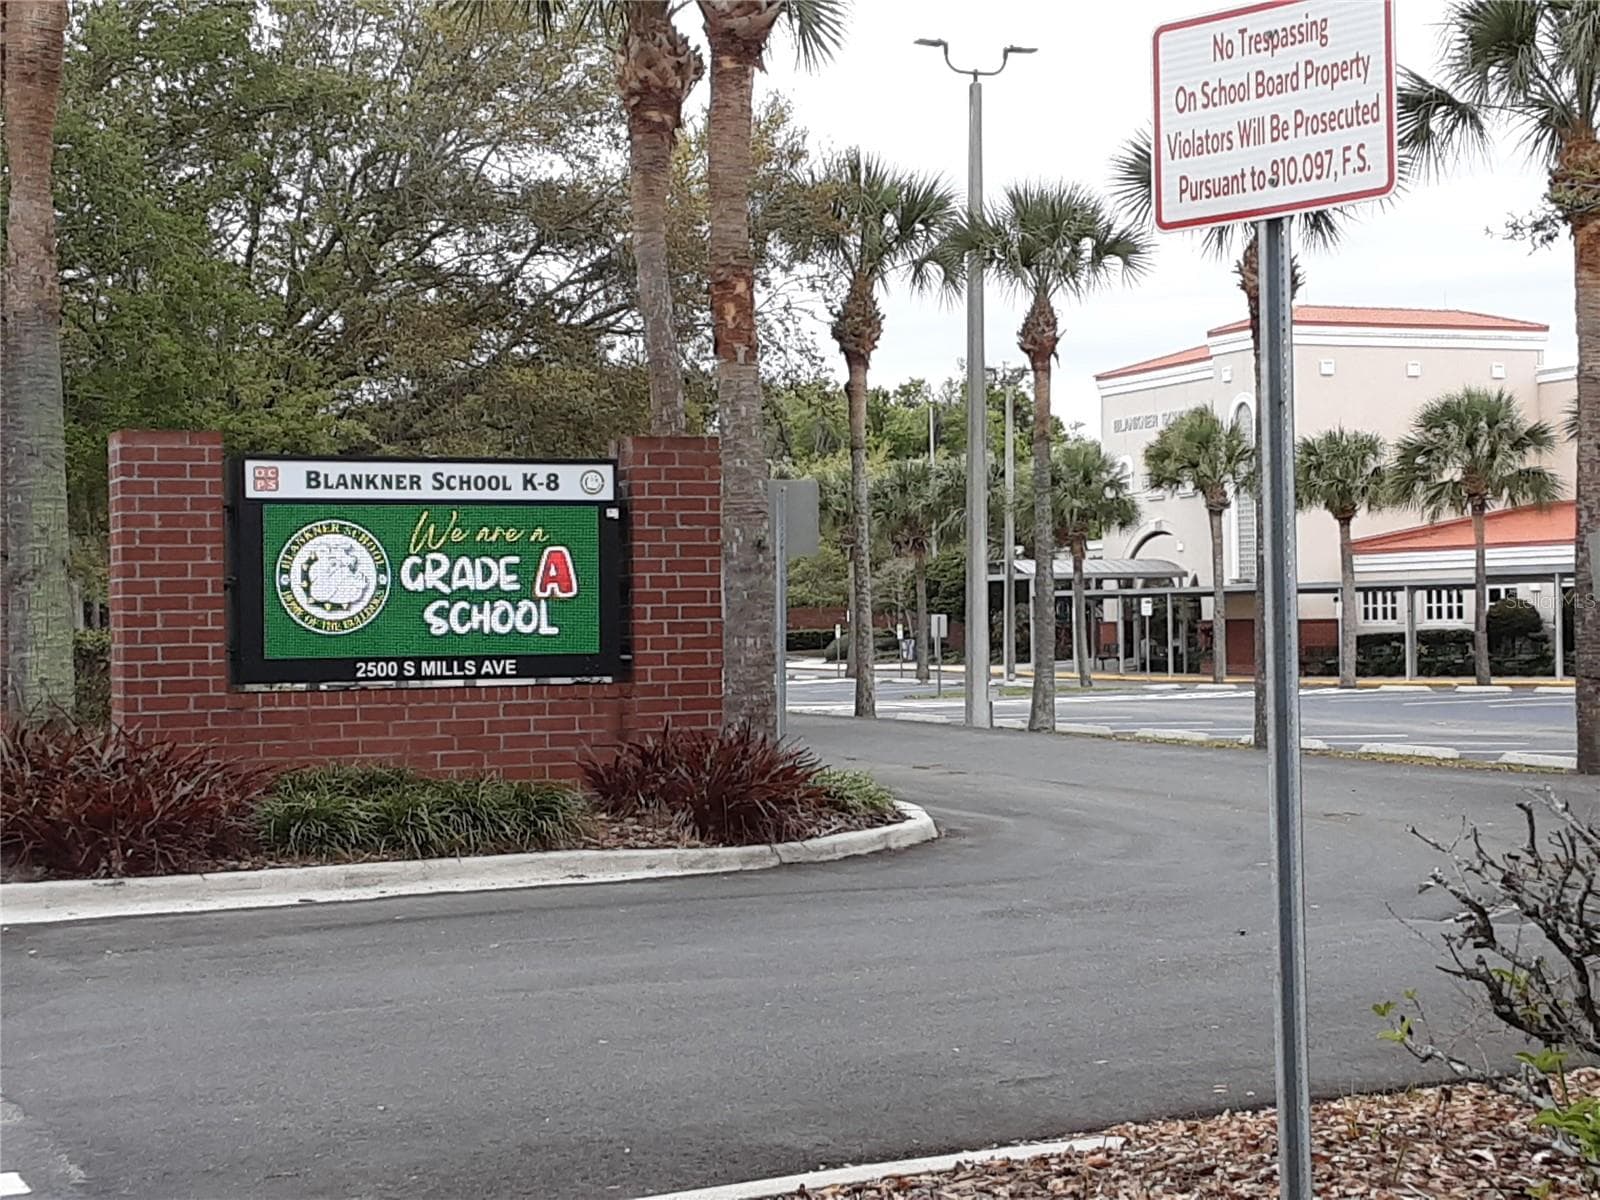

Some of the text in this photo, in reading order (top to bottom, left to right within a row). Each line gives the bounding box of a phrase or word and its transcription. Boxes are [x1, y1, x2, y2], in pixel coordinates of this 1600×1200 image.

[1213, 13, 1328, 62] No Trespassing
[1175, 51, 1371, 114] On School Board Property
[1167, 93, 1380, 161] Violators Will Be Prosecuted
[1179, 171, 1246, 204] Pursuant
[1250, 165, 1265, 190] to
[1342, 143, 1371, 177] F.S.
[305, 470, 560, 491] BLANKNER SCHOOL K-8
[408, 511, 550, 555] We are a
[400, 545, 578, 599] GRADE A
[423, 599, 560, 636] SCHOOL
[356, 659, 517, 677] 2500 S MILLS AVE
